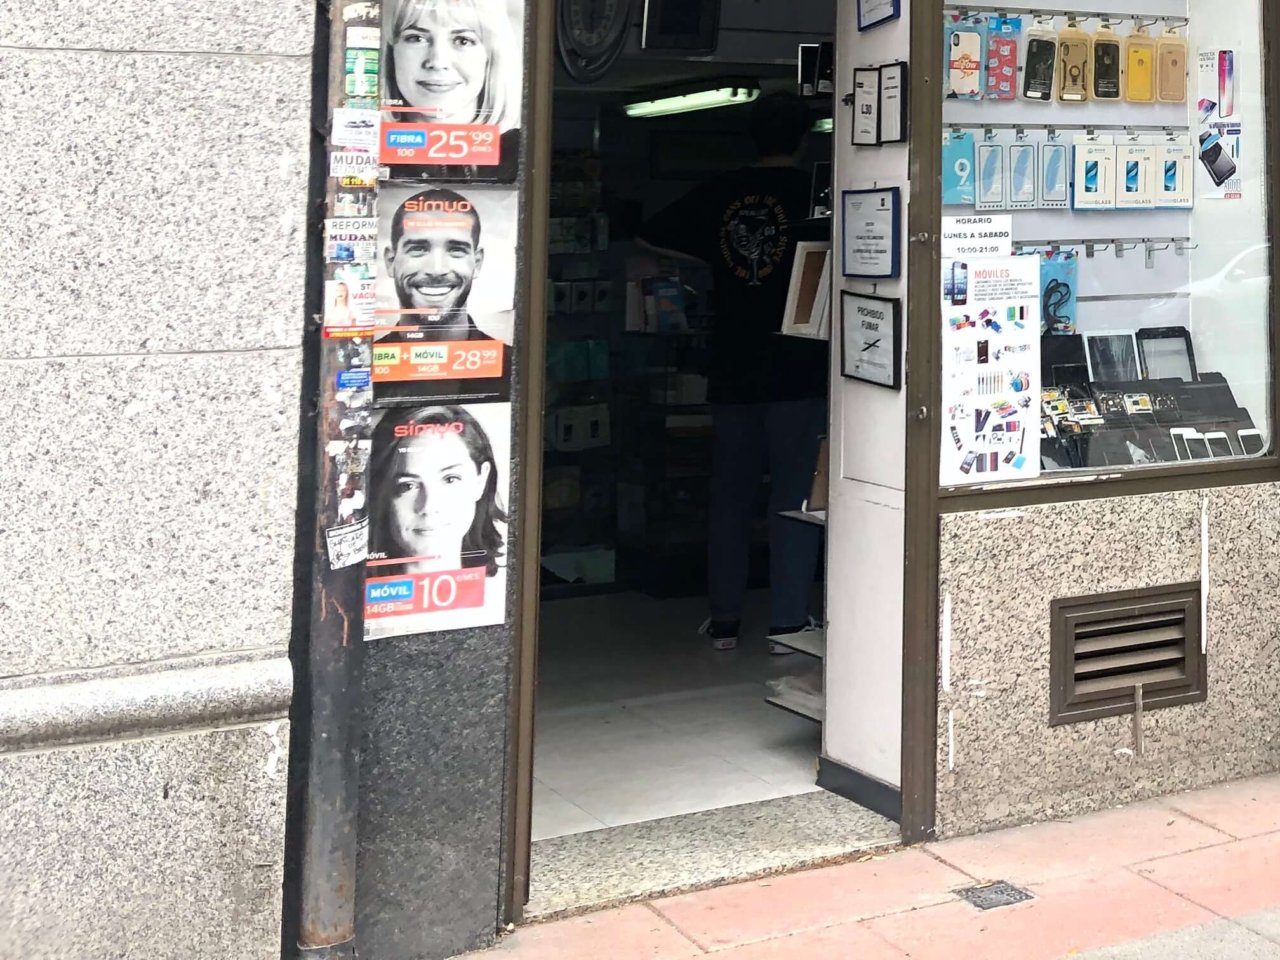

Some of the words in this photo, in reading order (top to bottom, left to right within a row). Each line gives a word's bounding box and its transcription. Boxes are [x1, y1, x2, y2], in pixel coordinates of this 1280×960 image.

[390, 134, 423, 144] FIBRA
[428, 130, 468, 158] 25
[397, 149, 415, 157] 100
[956, 217, 992, 225] HORARIO
[978, 231, 1009, 239] SABADO
[414, 348, 443, 359] MÓVIL
[452, 350, 480, 370] 28
[371, 583, 410, 598] MÓVIL
[419, 574, 456, 609] 10
